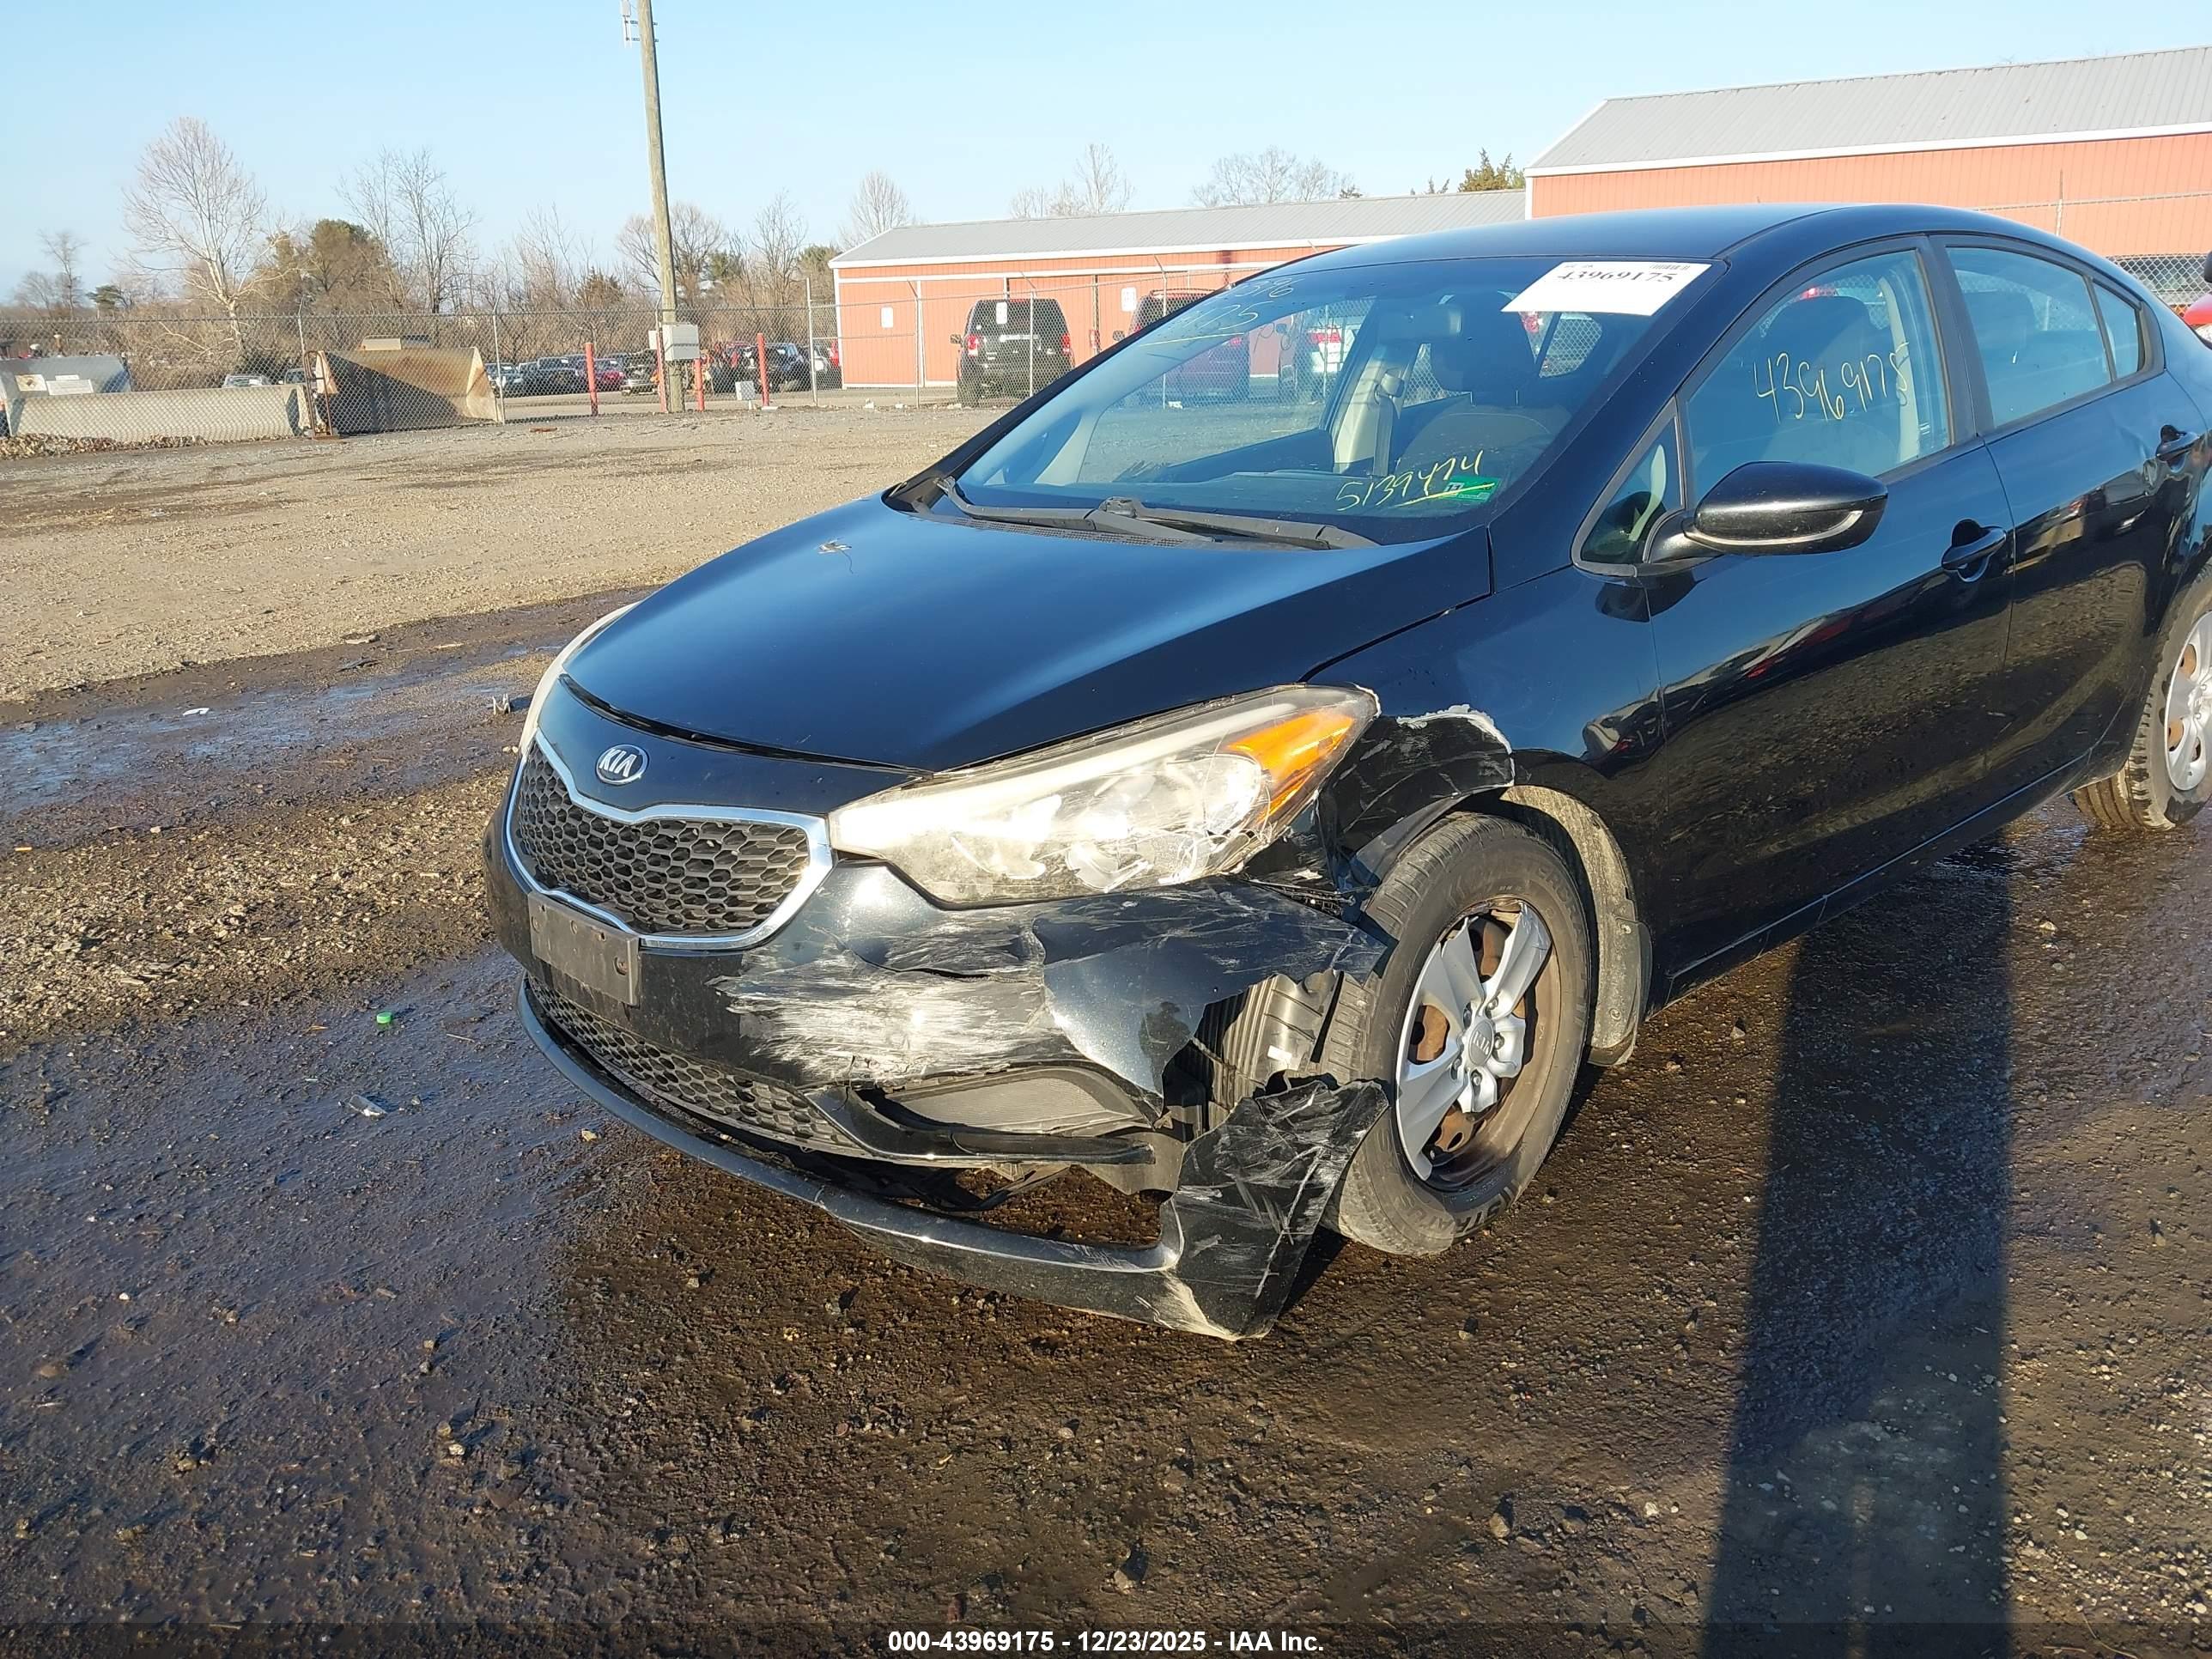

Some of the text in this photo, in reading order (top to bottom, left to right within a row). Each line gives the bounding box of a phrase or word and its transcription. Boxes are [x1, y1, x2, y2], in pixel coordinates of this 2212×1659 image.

[1557, 270, 1678, 283] 43969175
[599, 748, 637, 778] KIA
[1473, 1030, 1492, 1055] KIA
